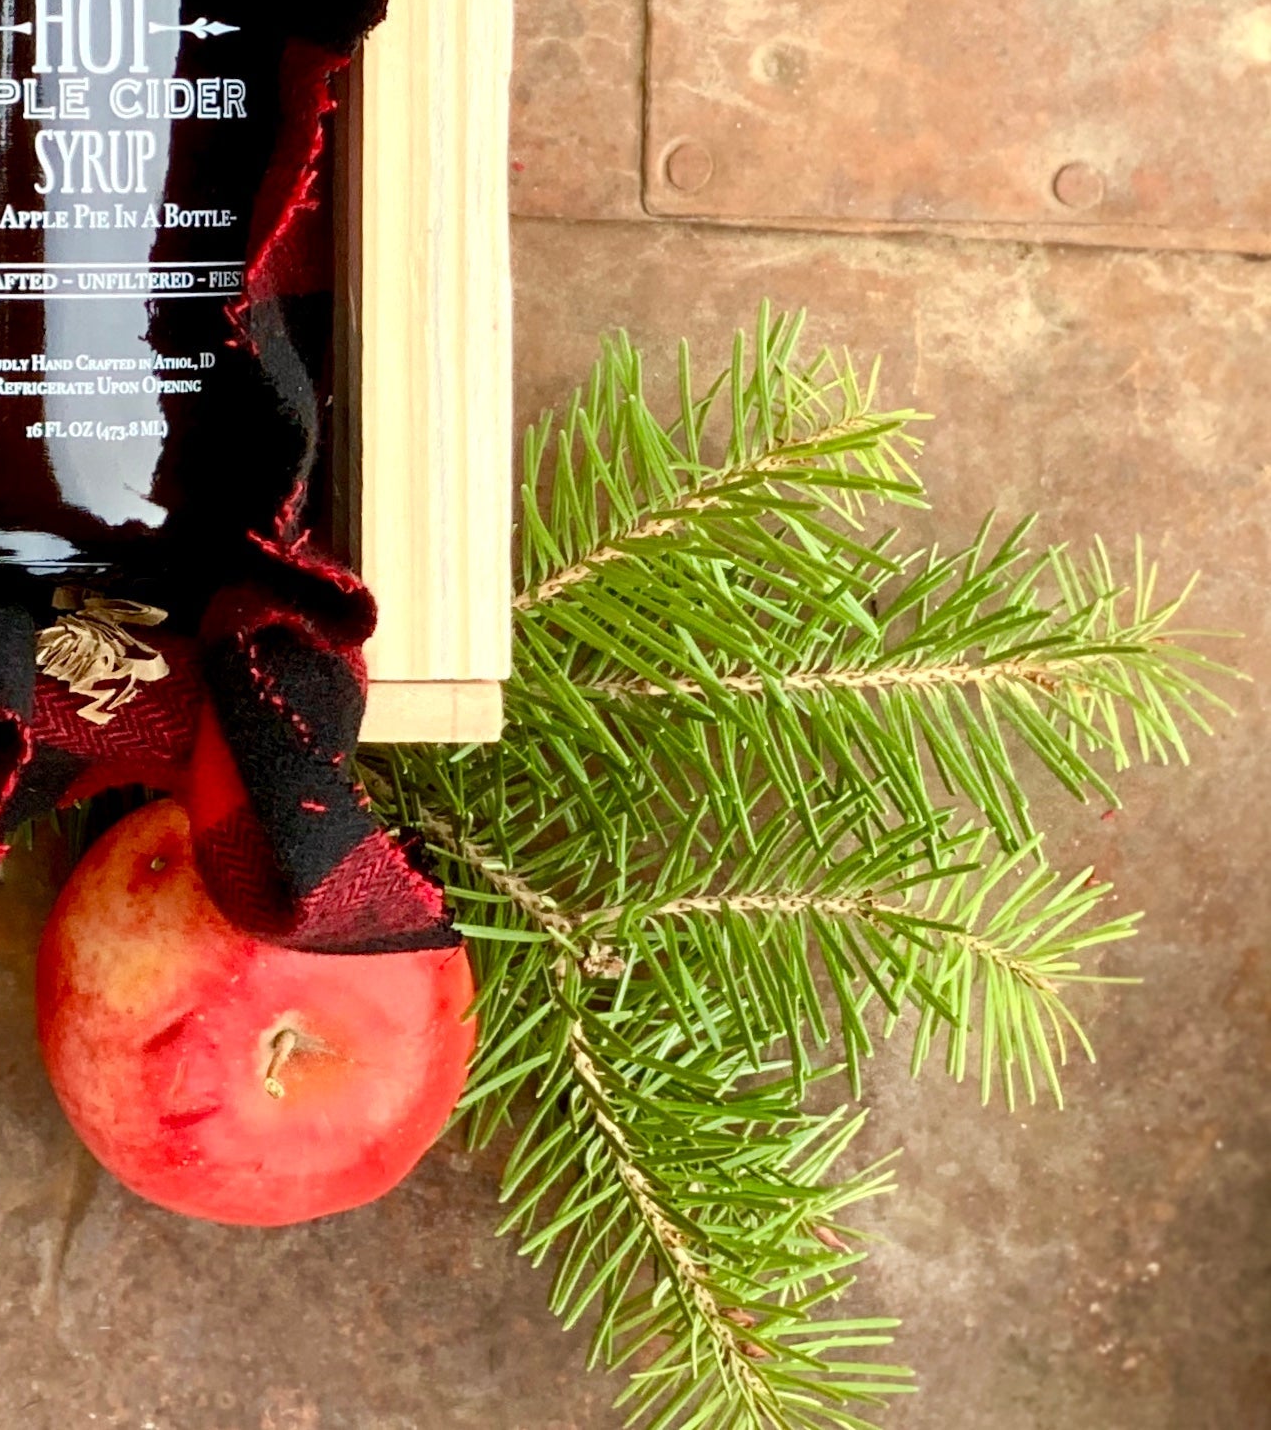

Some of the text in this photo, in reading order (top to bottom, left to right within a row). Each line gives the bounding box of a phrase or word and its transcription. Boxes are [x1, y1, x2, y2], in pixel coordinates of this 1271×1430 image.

[109, 78, 247, 119] CIDER
[34, 130, 156, 195] SYRUP
[74, 205, 110, 229] PIE
[114, 204, 138, 228] IN
[142, 204, 162, 228] A
[164, 203, 237, 228] BOTTLE-
[77, 272, 194, 290] UNFILTERED
[32, 355, 73, 370] HAND
[75, 354, 136, 370] CRAFTED
[199, 353, 215, 368] ID
[97, 379, 140, 395] UPON
[142, 377, 202, 394] OPENING
[26, 420, 168, 441] 16 FL OZ (473.8 ML)
